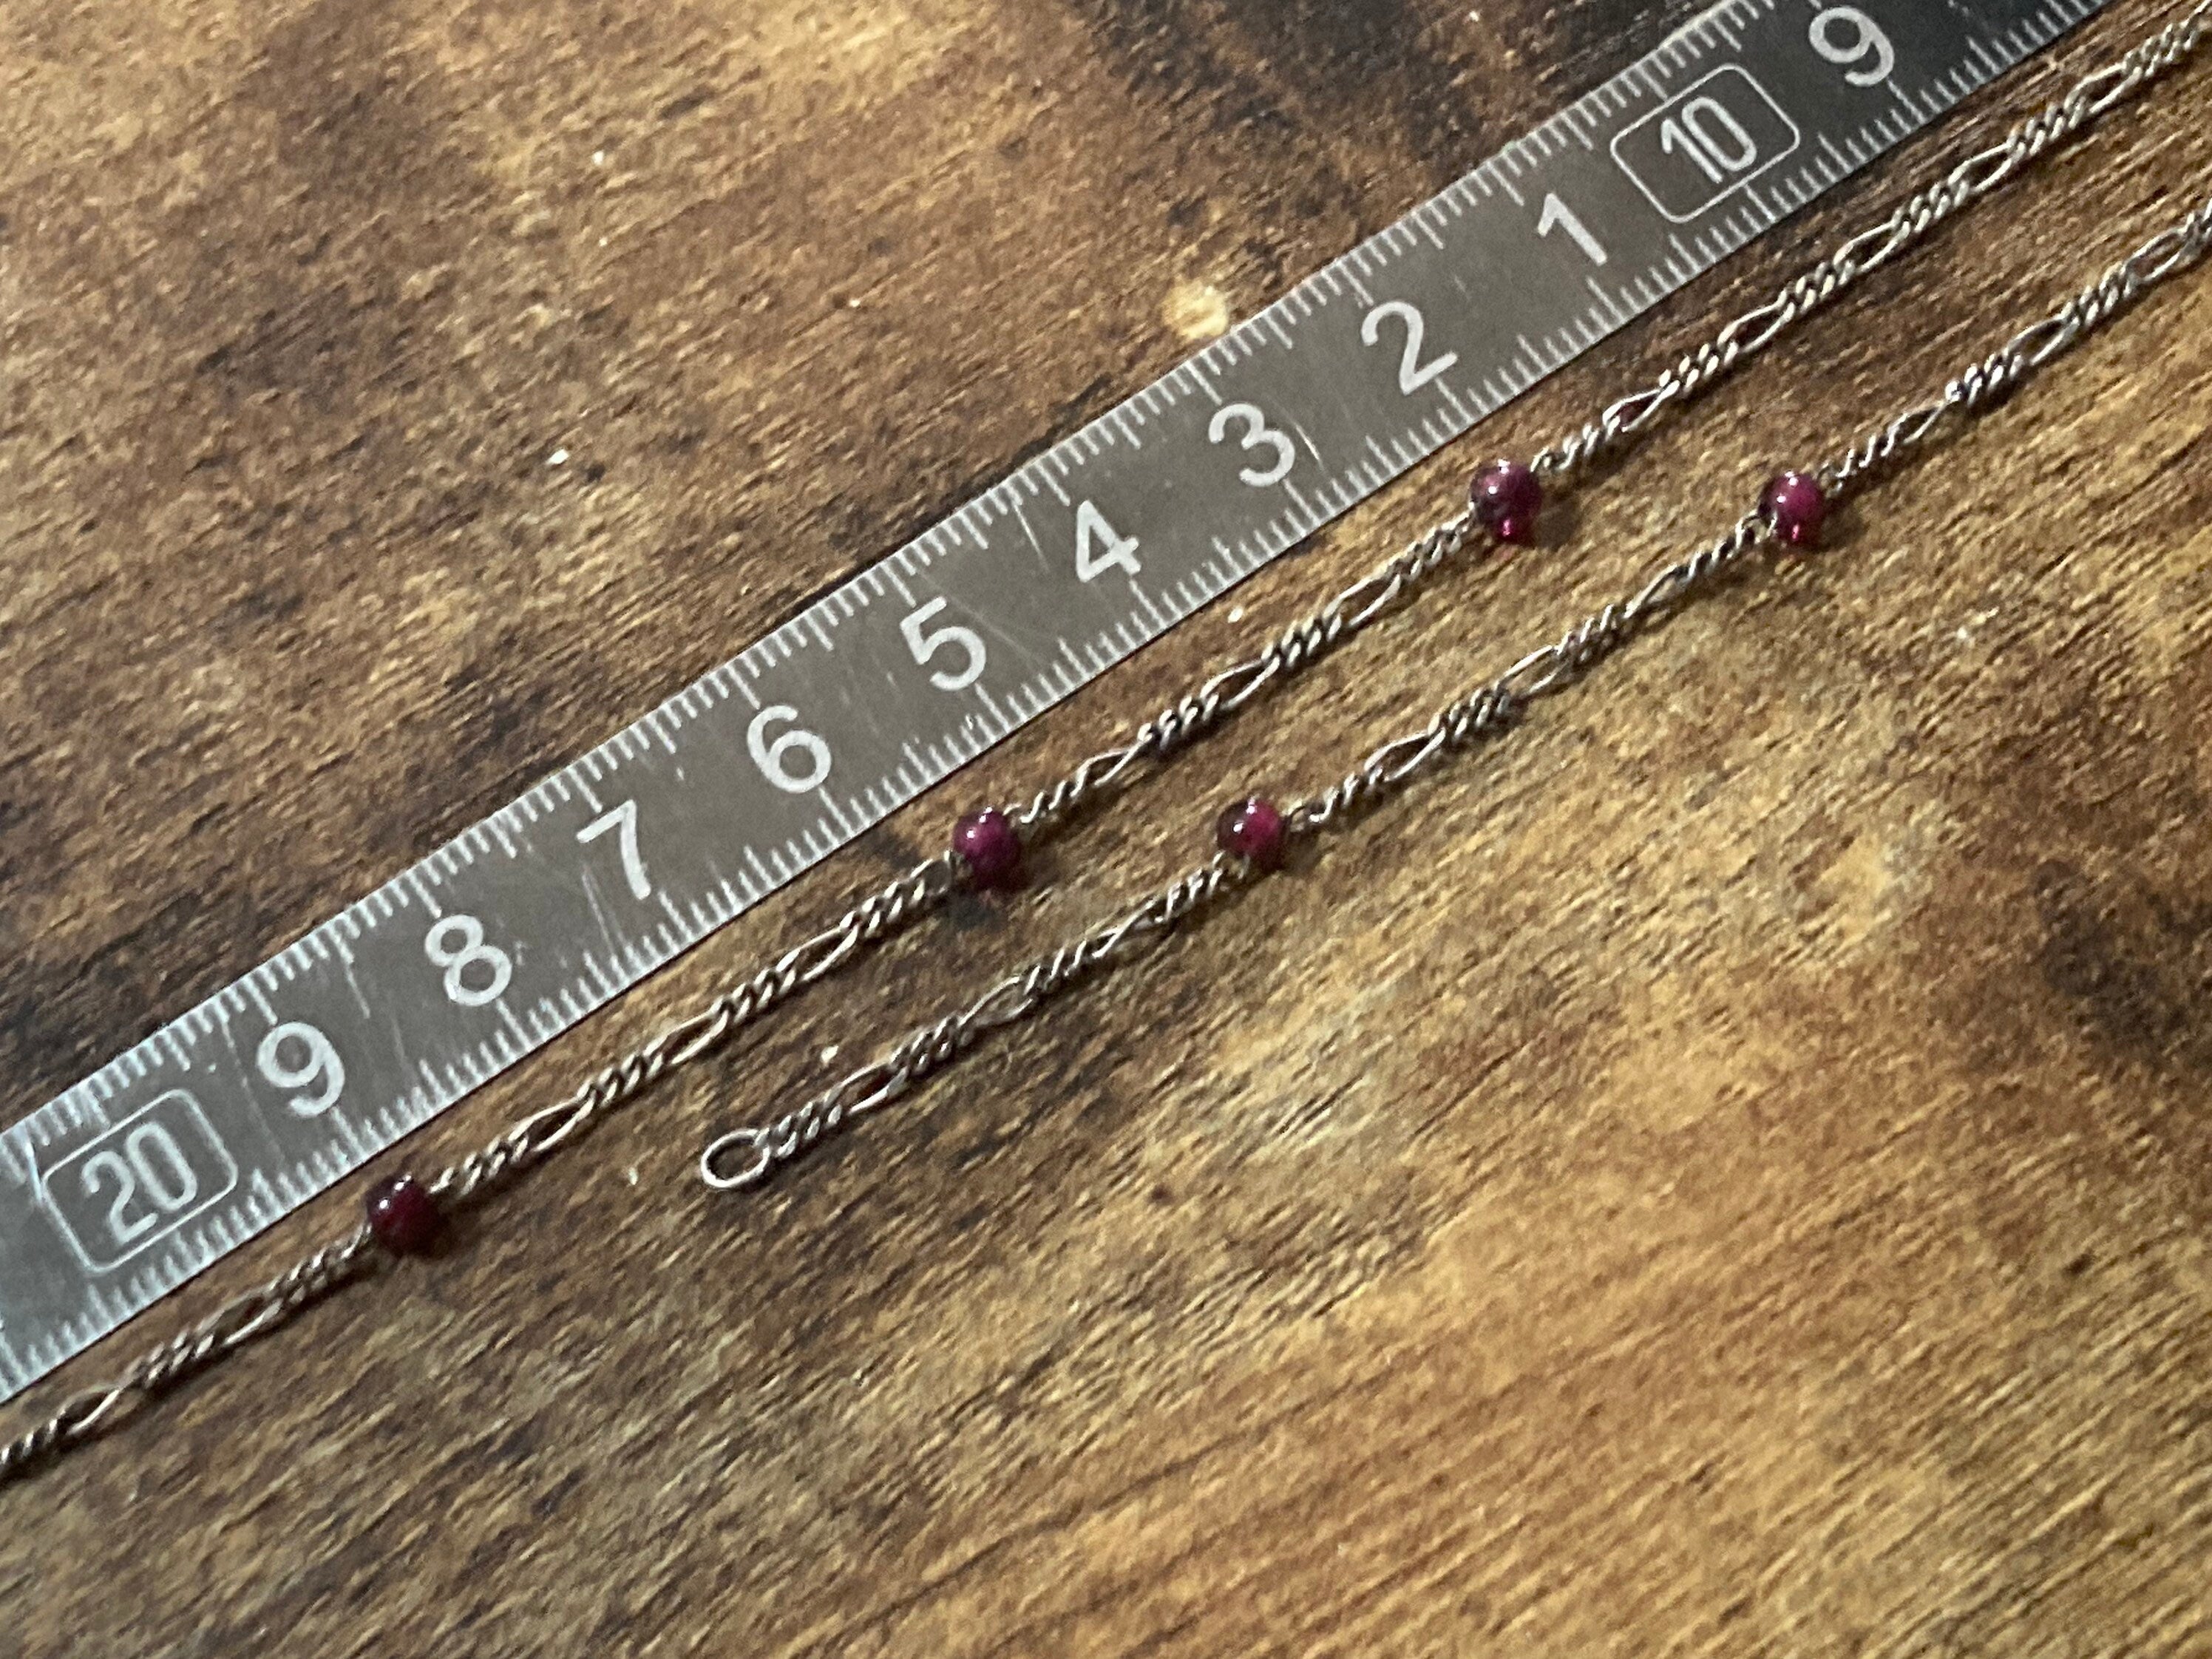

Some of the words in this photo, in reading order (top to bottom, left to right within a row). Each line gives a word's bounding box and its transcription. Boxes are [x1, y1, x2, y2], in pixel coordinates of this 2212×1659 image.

[1808, 5, 1895, 86] 9
[1660, 96, 1757, 184] 10
[1537, 192, 1607, 266] 1
[1360, 300, 1458, 395] 2
[1208, 403, 1295, 487] 3
[1076, 499, 1141, 583] 4
[899, 595, 986, 691] 5
[747, 705, 832, 793] 6
[577, 798, 651, 900] 7
[424, 914, 512, 1007] 8
[257, 1021, 345, 1118] 9
[81, 1121, 197, 1246] 20
